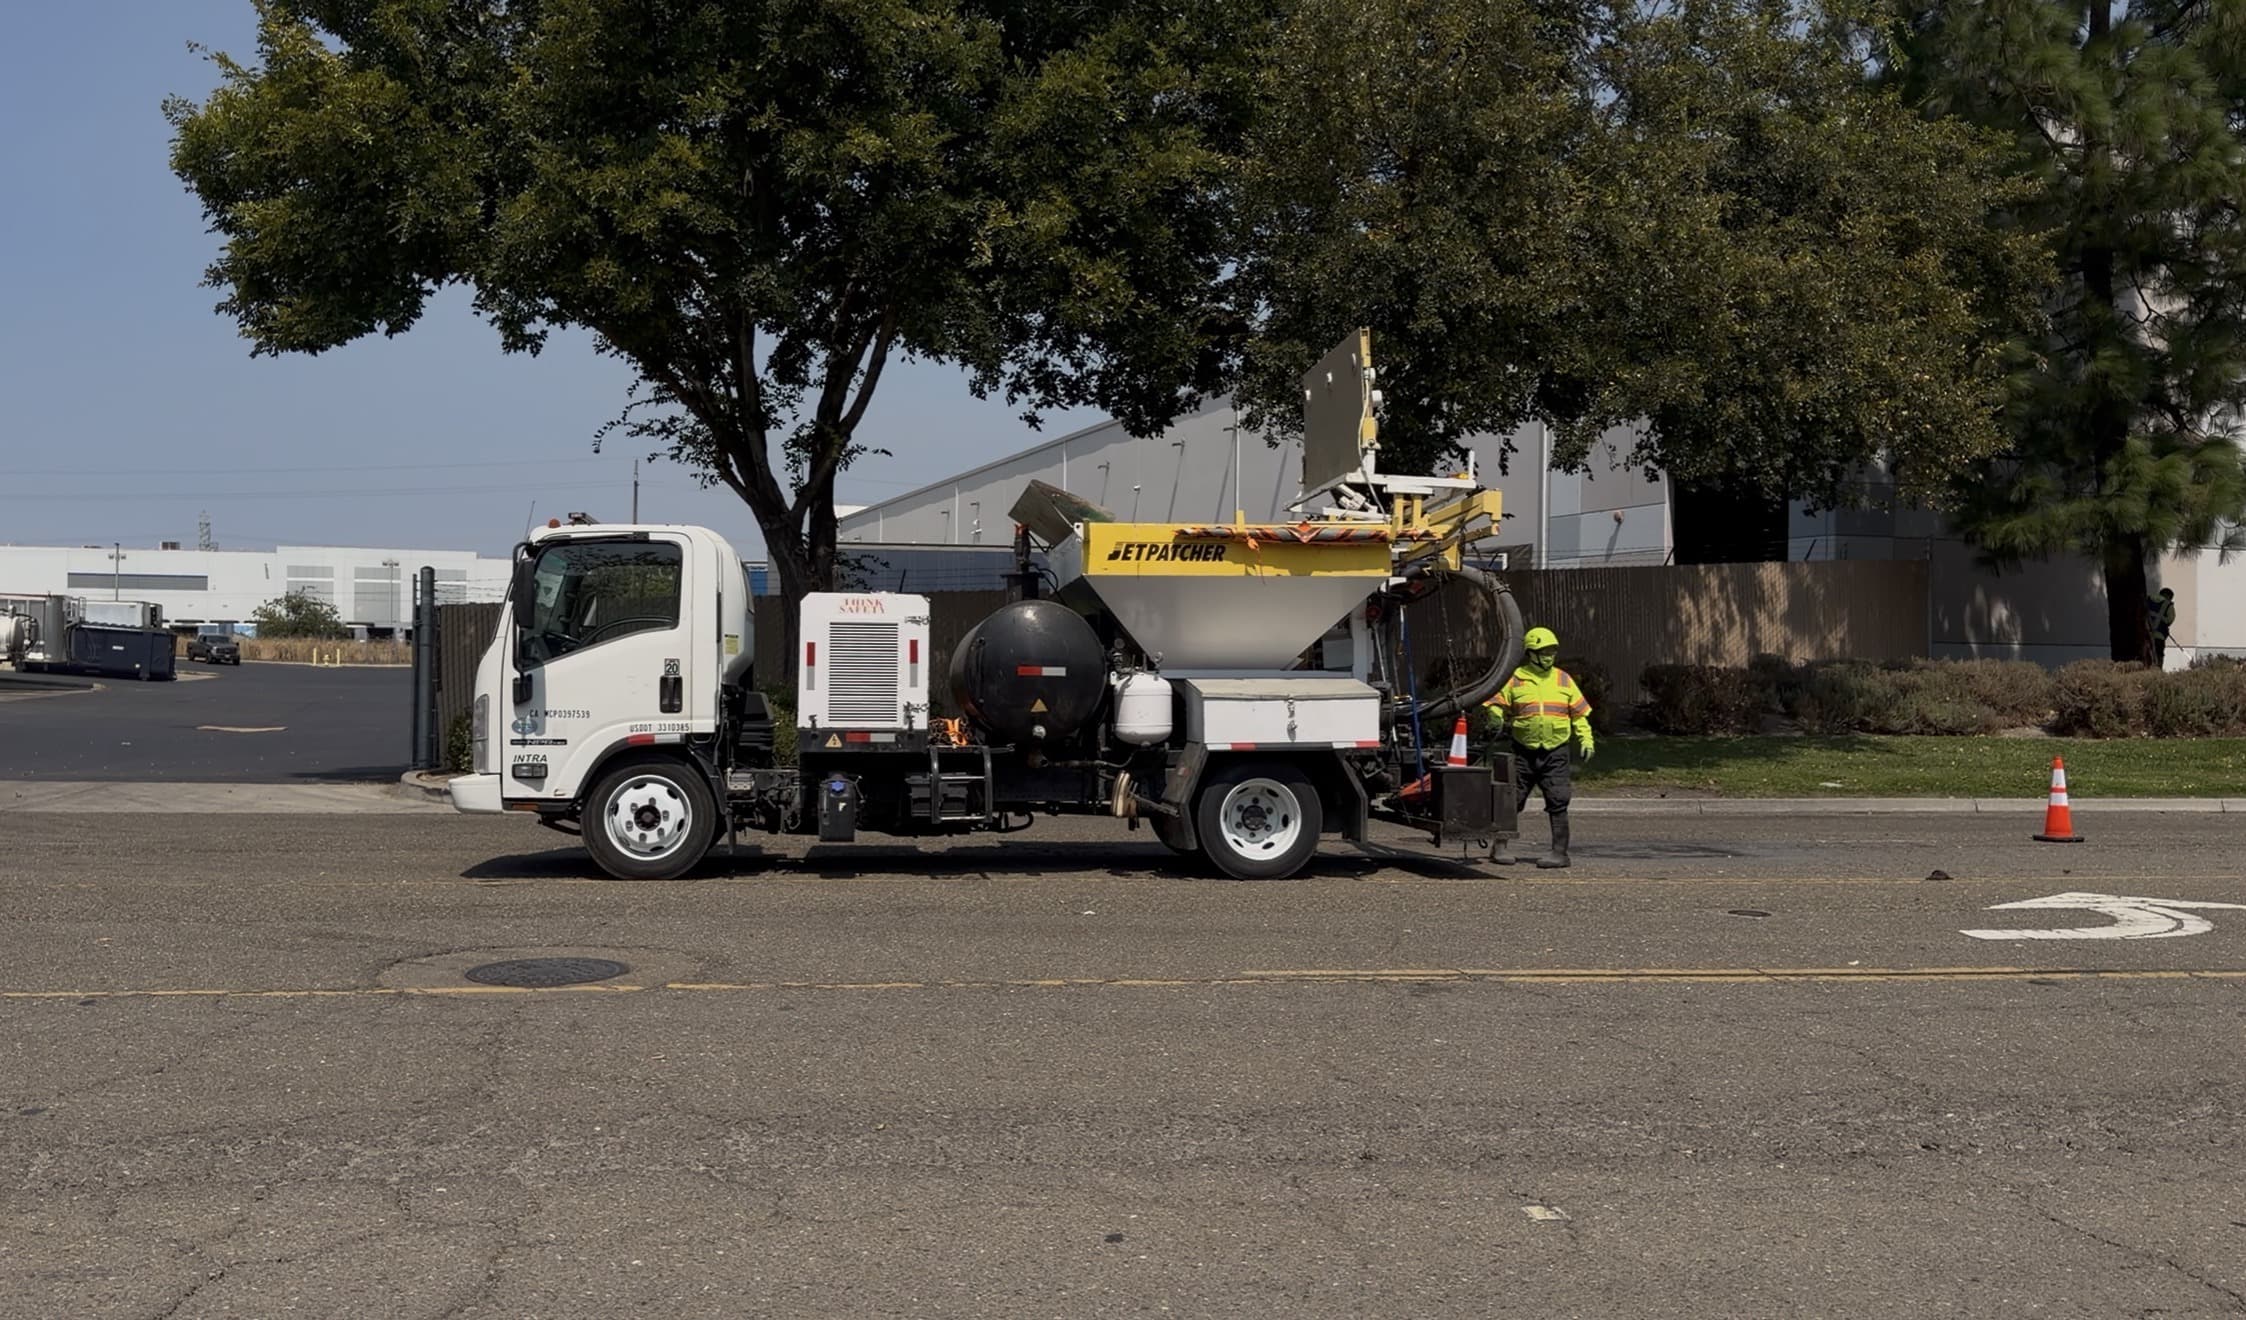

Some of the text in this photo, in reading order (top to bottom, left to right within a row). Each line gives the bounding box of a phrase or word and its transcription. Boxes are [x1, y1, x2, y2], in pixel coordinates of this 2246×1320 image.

[1107, 541, 1226, 561] JETPATCHER
[840, 606, 886, 614] SAFETY
[665, 663, 679, 673] 20
[630, 723, 652, 732] USDOT
[513, 754, 547, 763] INTRA
